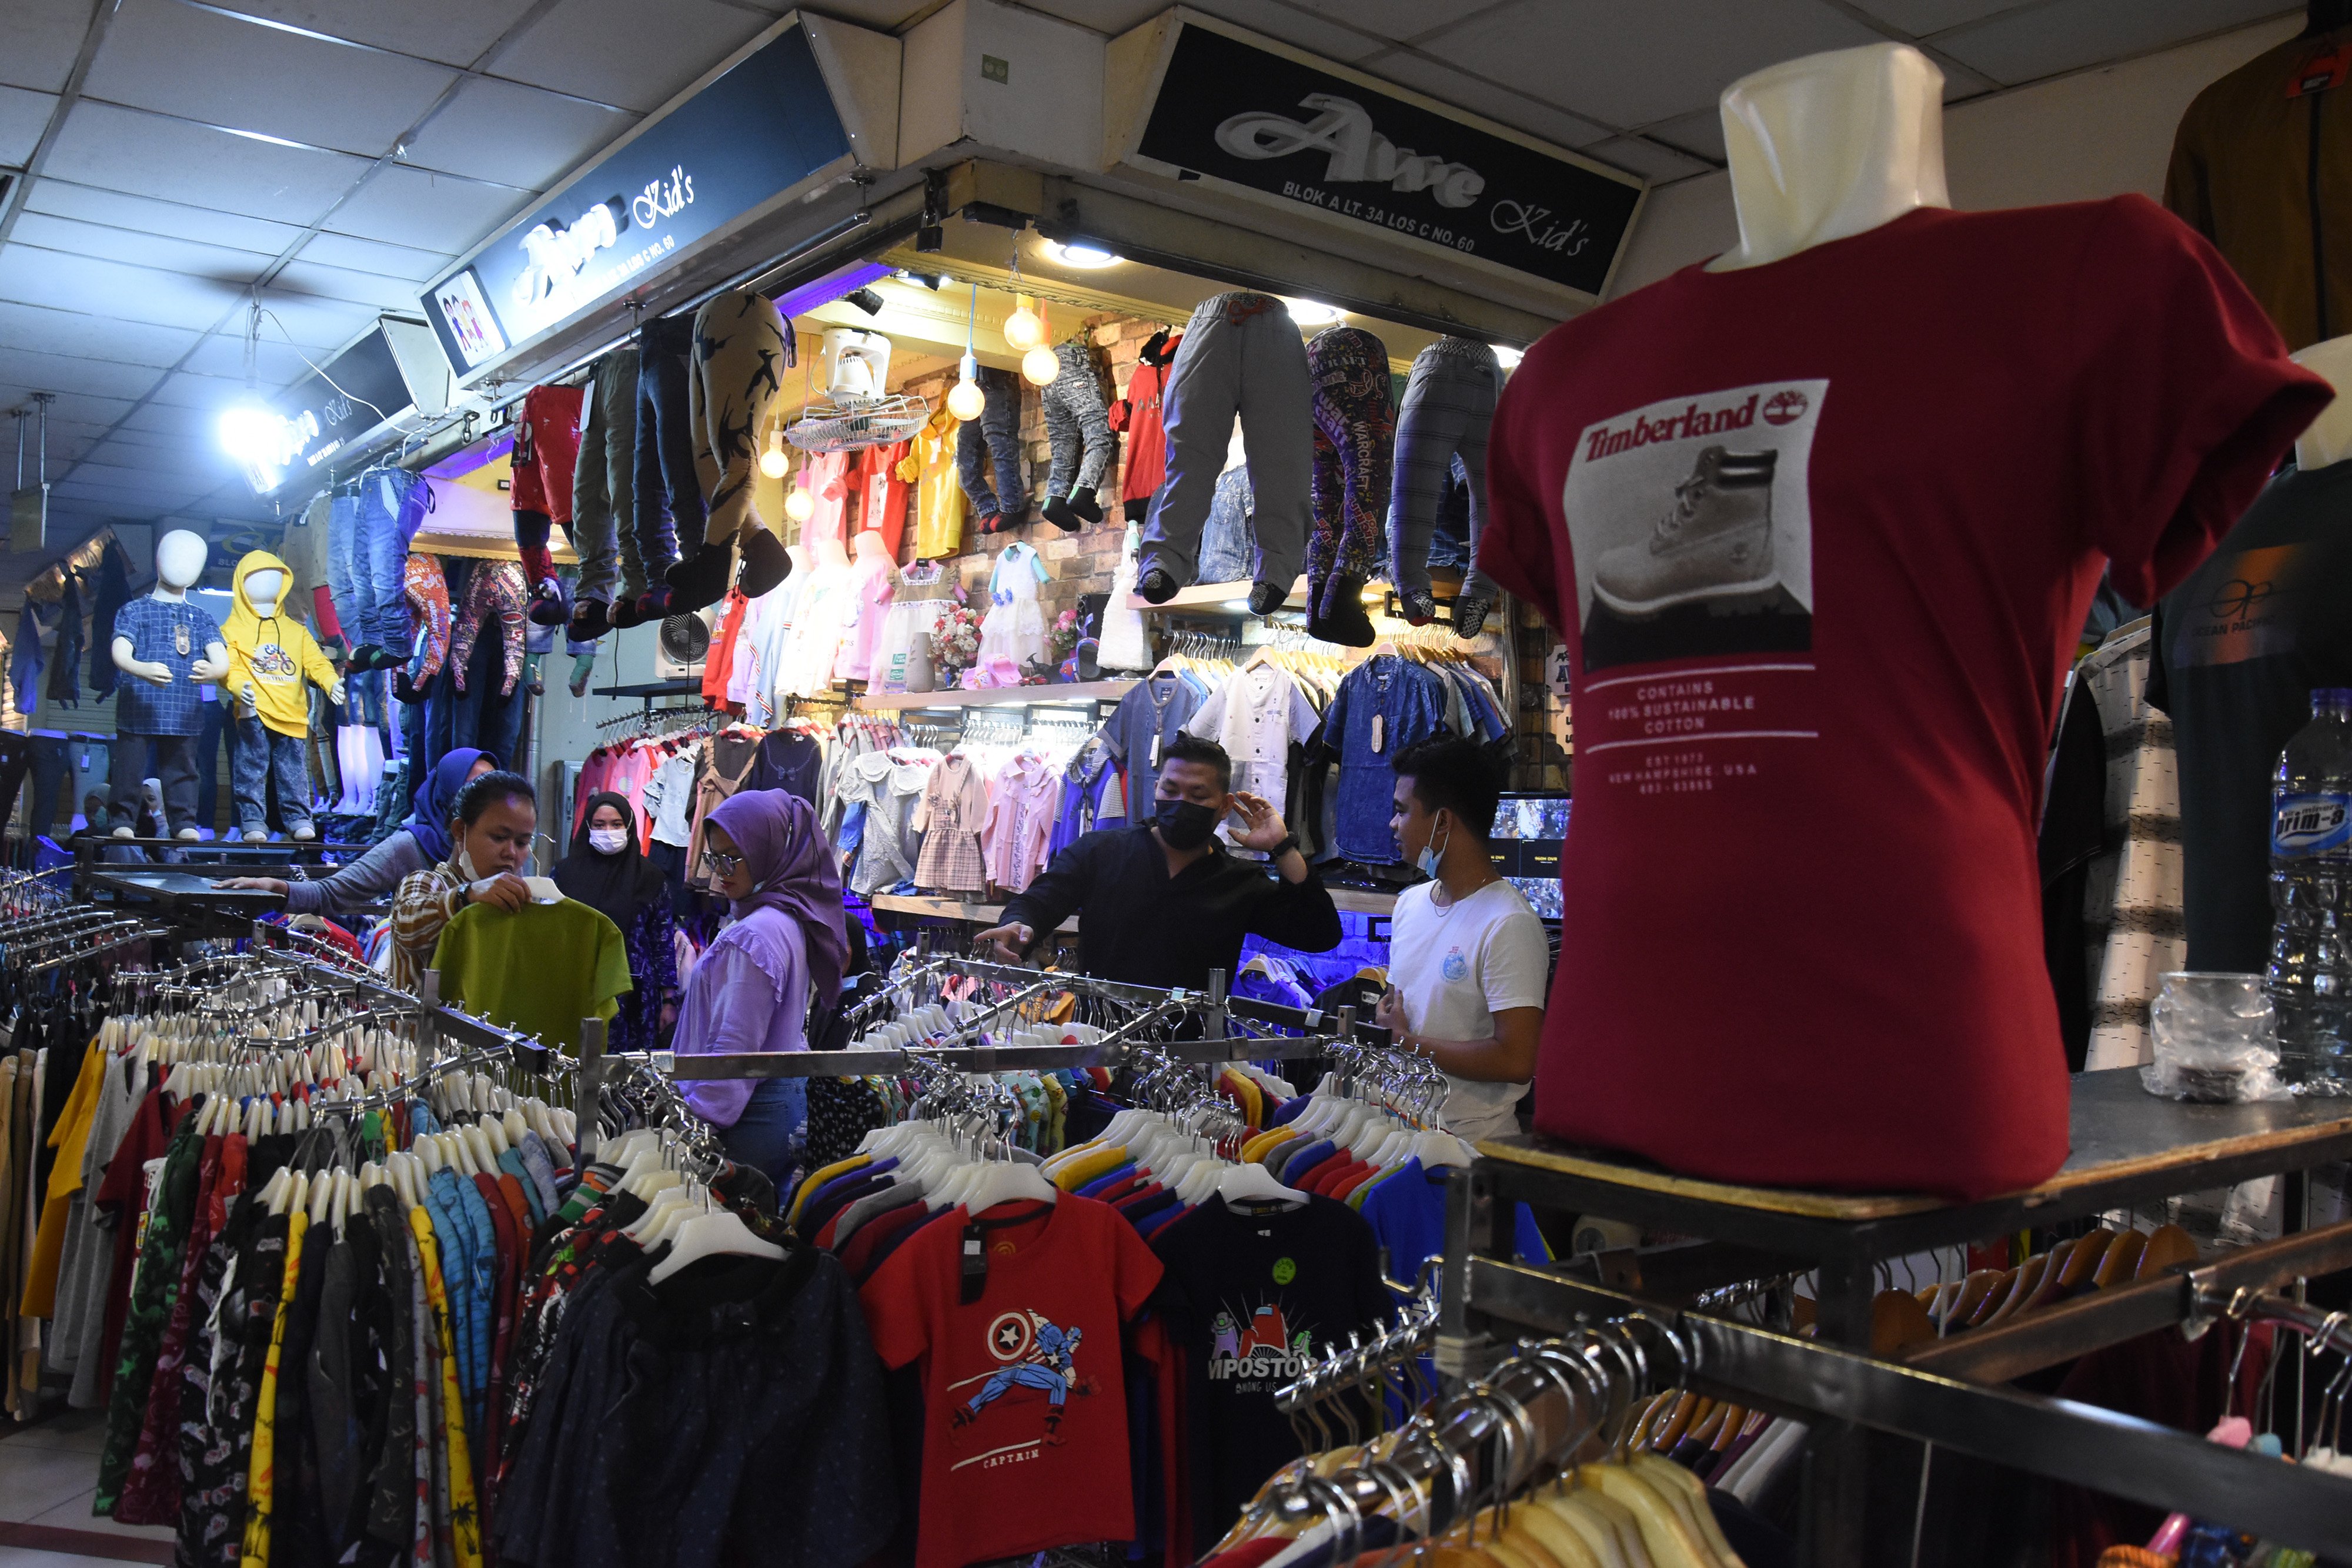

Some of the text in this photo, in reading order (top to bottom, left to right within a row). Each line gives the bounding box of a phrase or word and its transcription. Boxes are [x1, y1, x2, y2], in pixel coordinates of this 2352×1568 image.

[632, 165, 694, 229] Kid's
[1282, 180, 1475, 252] BLOK A LT. 3A LOS C NO. 60
[1491, 200, 1589, 256] Kid's
[643, 249, 652, 262] C
[649, 242, 665, 258] NO.
[663, 235, 675, 248] 60
[1585, 393, 1760, 463] Timberland
[1353, 420, 1372, 490] WARCRAFT
[1636, 681, 1713, 701] CONTAINS
[1643, 696, 1755, 717] SUSTAINABLE
[1645, 716, 1705, 734] COTTON
[1265, 1382, 1278, 1393] US
[983, 1449, 1038, 1469] CAPTAIN
